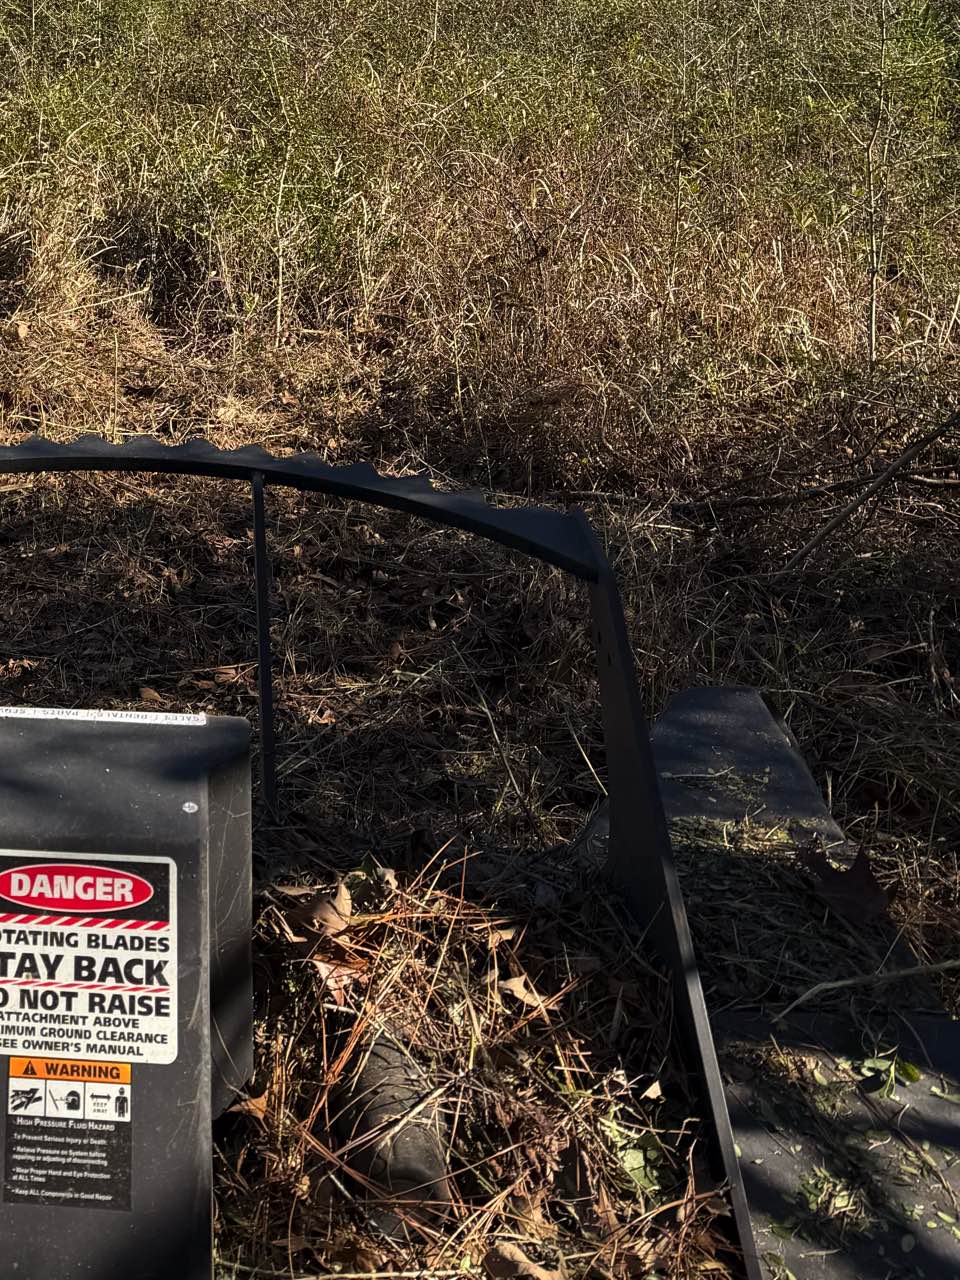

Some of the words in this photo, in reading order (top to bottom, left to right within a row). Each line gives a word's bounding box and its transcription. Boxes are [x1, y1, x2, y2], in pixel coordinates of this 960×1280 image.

[10, 873, 134, 903] DANGER
[87, 934, 170, 953] BLADES
[73, 955, 169, 986] BACK
[19, 989, 79, 1011] NOT
[88, 993, 171, 1017] RAISE
[93, 1016, 140, 1029] ABOVE
[40, 1027, 92, 1040] GROUND
[96, 1030, 169, 1045] CLEARANCE
[22, 1039, 81, 1053] OWNER'S
[86, 1044, 144, 1056] MANUAL
[44, 1062, 121, 1079] WARNING
[16, 1117, 33, 1126] HIGH
[34, 1118, 67, 1129] PRESSURE
[68, 1120, 87, 1130] FLUID
[88, 1121, 115, 1131] HAZARD
[22, 1133, 43, 1141] Prevent
[43, 1135, 65, 1143] Serious
[65, 1136, 81, 1145] Injury
[36, 1147, 60, 1155] Pressure
